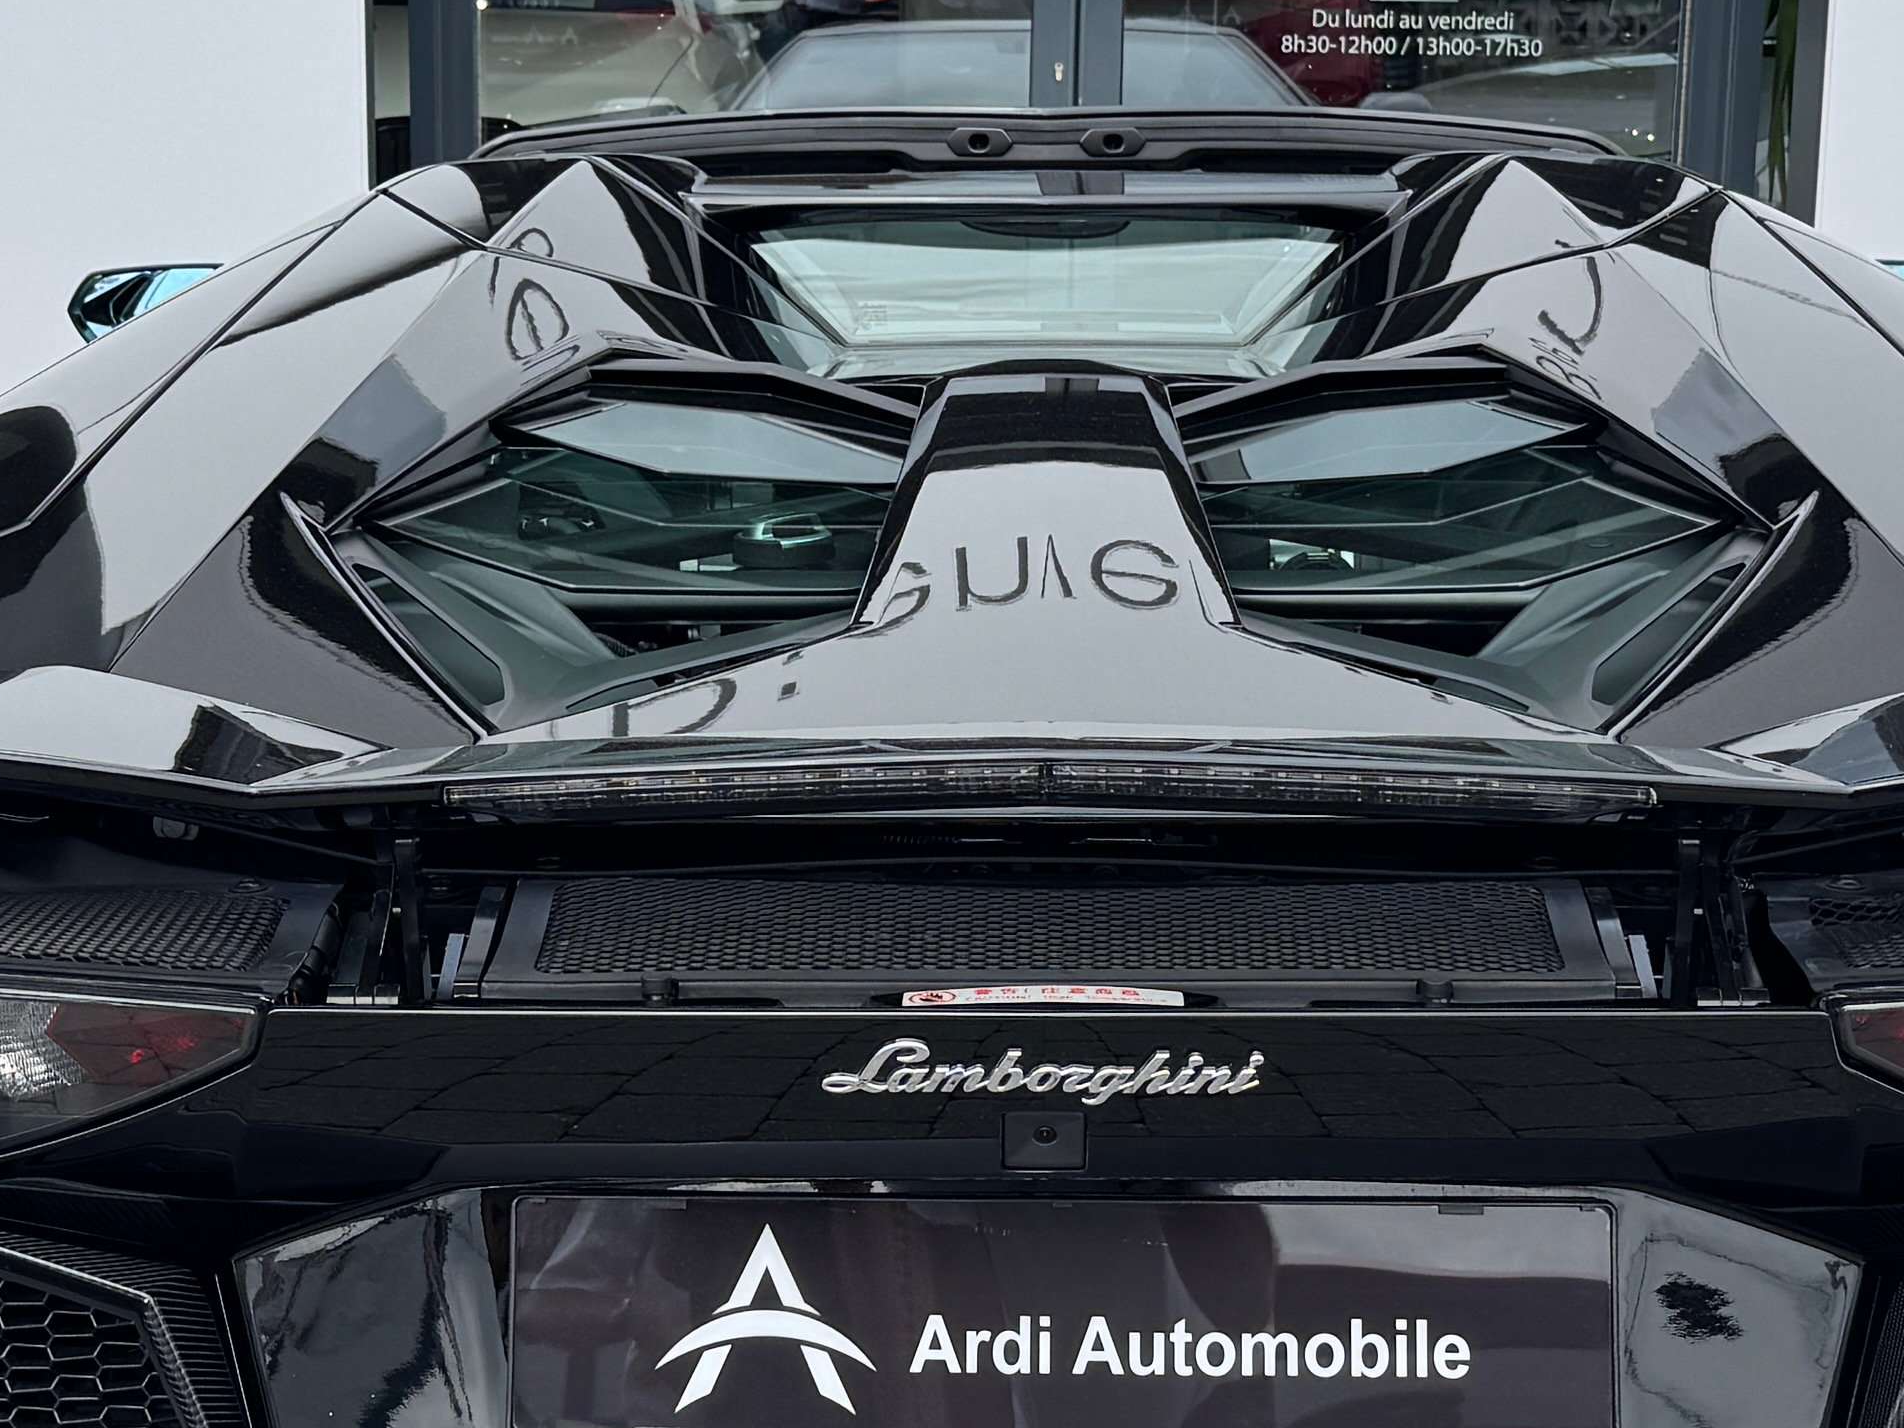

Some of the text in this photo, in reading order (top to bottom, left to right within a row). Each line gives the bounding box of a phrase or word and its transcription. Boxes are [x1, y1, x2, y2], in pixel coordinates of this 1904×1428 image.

[1312, 10, 1514, 32] Du lundi au vendredi
[1280, 34, 1396, 55] 8h30-12h00
[1416, 36, 1543, 58] 13h00-17h30
[821, 1037, 1264, 1105] Lamborghini
[909, 1313, 1471, 1380] Ardi Automobile
